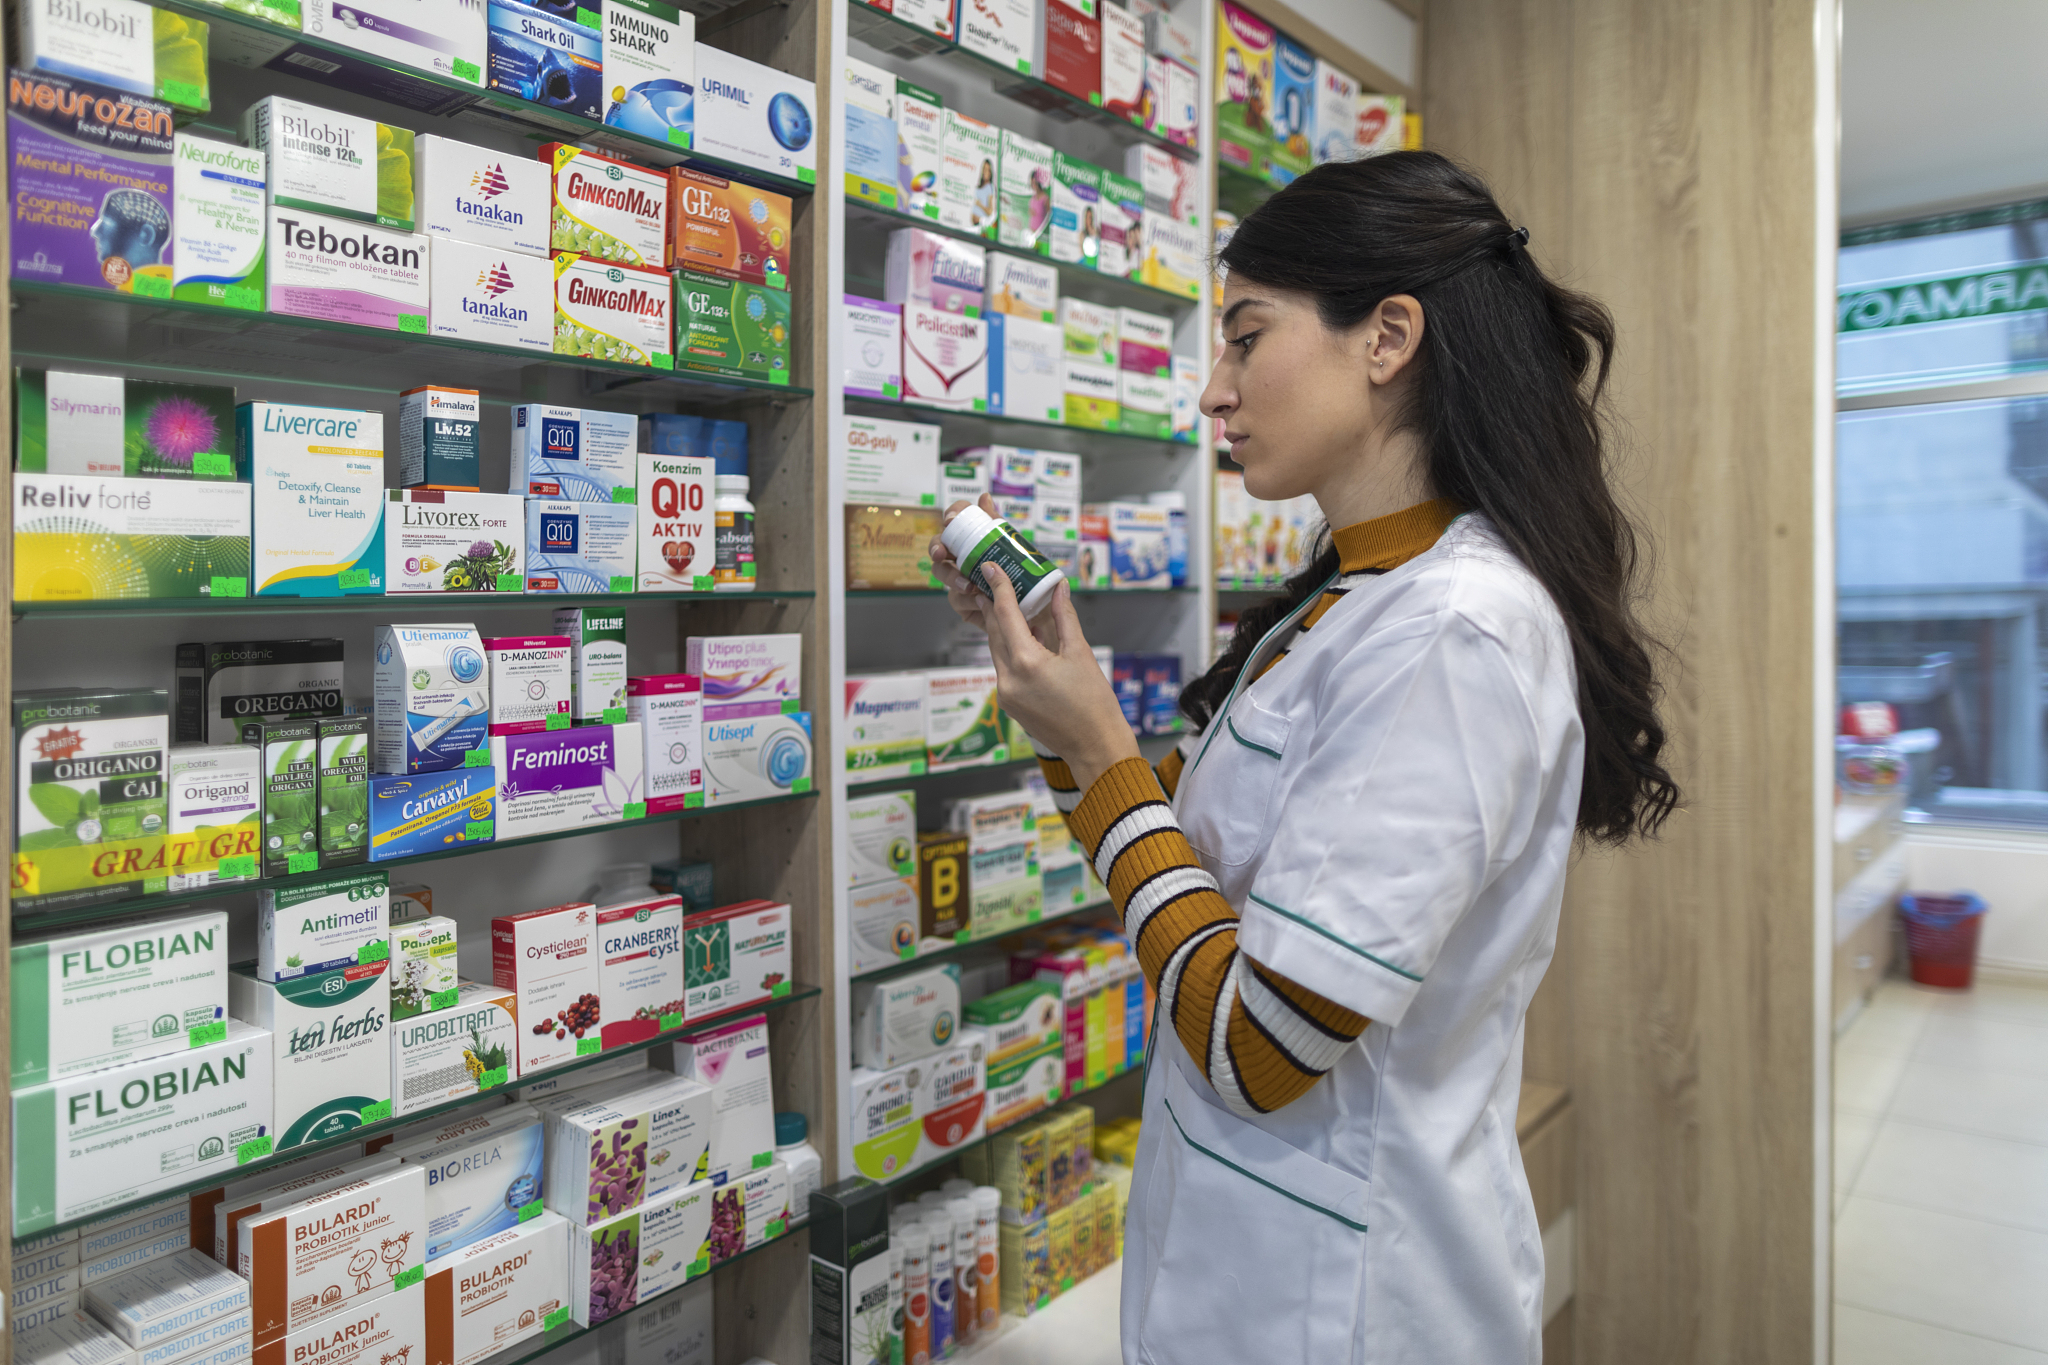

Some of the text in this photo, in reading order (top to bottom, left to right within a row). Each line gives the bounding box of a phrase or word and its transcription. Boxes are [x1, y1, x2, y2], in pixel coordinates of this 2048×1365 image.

[363, 16, 374, 27] 60
[610, 10, 669, 43] IMMUNO
[521, 19, 575, 51] Shark Oil
[610, 28, 656, 57] SHARK
[702, 77, 749, 105] URIMIL
[9, 78, 173, 137] Neurozan
[78, 120, 173, 151] feed your mind
[281, 115, 351, 148] Bilobil
[283, 139, 332, 158] intense
[16, 153, 72, 175] Mental
[74, 163, 168, 194] Performance
[609, 167, 621, 180] ESI
[16, 191, 96, 219] Cognitive
[196, 204, 234, 221] Healthy
[235, 211, 260, 226] Brain
[455, 197, 524, 226] tanakan
[16, 206, 88, 230] Function
[225, 219, 259, 235] Nerves
[277, 218, 420, 270] Tebokan
[286, 250, 298, 260] 40
[300, 254, 315, 265] mg
[316, 254, 349, 268] filmom
[390, 268, 420, 281] tablete
[609, 269, 622, 282] ESI
[462, 297, 528, 323] tanakan
[689, 322, 718, 333] NATURAL
[50, 397, 122, 417] Silymarin
[430, 396, 475, 412] Himalaya
[549, 408, 573, 417] ALKAKAPS
[264, 408, 358, 439] Livercare
[434, 421, 472, 438] Liv.52
[547, 427, 574, 449] Q10
[317, 447, 380, 457] PROLONGED RELEASE
[653, 460, 703, 476] Koenzim
[21, 485, 151, 510] Reliv forte
[278, 479, 362, 495] Detoxify, Cleanse
[298, 495, 350, 507] & Maintain
[547, 504, 572, 512] ALKAKAPS
[652, 477, 704, 520] Q10
[308, 508, 367, 521] Liver Health
[402, 504, 507, 528] Livorex FORTE
[546, 523, 573, 542] Q10
[652, 523, 703, 537] AKTIV
[585, 618, 624, 632] LIFELINE
[402, 630, 469, 644] Utiemanoz
[211, 648, 273, 664] probotanic
[500, 651, 564, 662] D-MANOZINN
[588, 652, 623, 662] URO-balans
[707, 642, 743, 657] Utipro
[298, 679, 340, 689] ORGANIC
[21, 701, 101, 722] probotanic
[234, 692, 339, 715] OREGANO
[267, 727, 312, 740] probotanic
[321, 722, 363, 735] probotanic
[708, 723, 755, 743] Utisept
[54, 754, 158, 778] ORIGANO
[173, 759, 218, 772] probotanic
[342, 757, 365, 766] WILD
[512, 740, 608, 771] Feminost
[274, 771, 313, 783] DIVLJEG
[290, 762, 313, 772] ULJE
[324, 765, 366, 778] OREGANO
[271, 780, 313, 793] ORIGANA
[350, 774, 365, 783] OIL
[123, 782, 158, 800] ČAJ
[184, 781, 250, 801] Origanol
[221, 793, 250, 805] strong
[401, 776, 469, 821] Carvaxyl
[931, 856, 961, 909] B
[300, 904, 379, 936] Antimetil
[636, 910, 649, 921] ESI
[432, 943, 457, 956] kapsule
[526, 937, 588, 960] Cysticlean
[604, 924, 680, 955] CRANBERRY
[647, 939, 680, 961] cyst
[61, 928, 215, 979] FLOBIAN
[62, 997, 74, 1006] Za
[76, 989, 118, 1004] smanjenje
[119, 985, 151, 996] nervoze
[152, 980, 175, 989] creva
[179, 970, 216, 985] nadutosti
[325, 978, 345, 993] ESI
[289, 1005, 386, 1055] ten herbs
[402, 1007, 497, 1049] UROBITRAT
[293, 1054, 314, 1065] BILJNI
[314, 1047, 340, 1060] DIGESTIV
[345, 1038, 374, 1052] LAKSATIV
[695, 1027, 762, 1057] LACTIBIANE
[68, 1052, 247, 1125] FLOBIAN
[329, 1116, 340, 1127] 40
[652, 1107, 682, 1124] Linex
[69, 1147, 84, 1159] Za
[85, 1135, 134, 1153] smanjenje
[135, 1126, 174, 1139] nervoze
[174, 1118, 199, 1129] creva
[206, 1102, 248, 1122] nadutosti
[229, 1126, 257, 1139] kapsula
[323, 1122, 346, 1135] tableta
[229, 1133, 257, 1146] BILJNOG
[428, 1146, 503, 1188] BIORELA
[744, 1176, 771, 1192] Linex
[644, 1194, 700, 1224] Linex Forte
[294, 1199, 376, 1242] BULARDI
[86, 1208, 189, 1255] PROBIOTIC FORTE
[295, 1213, 391, 1256] PROBIOTIK junior
[86, 1233, 189, 1279] PROBIOTIC FORTE
[459, 1252, 529, 1294] BULARDI
[459, 1274, 516, 1306] PROBIOTIK
[140, 1290, 248, 1343] PROBIOTIC FORTE
[142, 1318, 251, 1364] PROBIOTIC FORTE
[293, 1314, 376, 1363] BULARDI
[362, 1328, 391, 1345] junior
